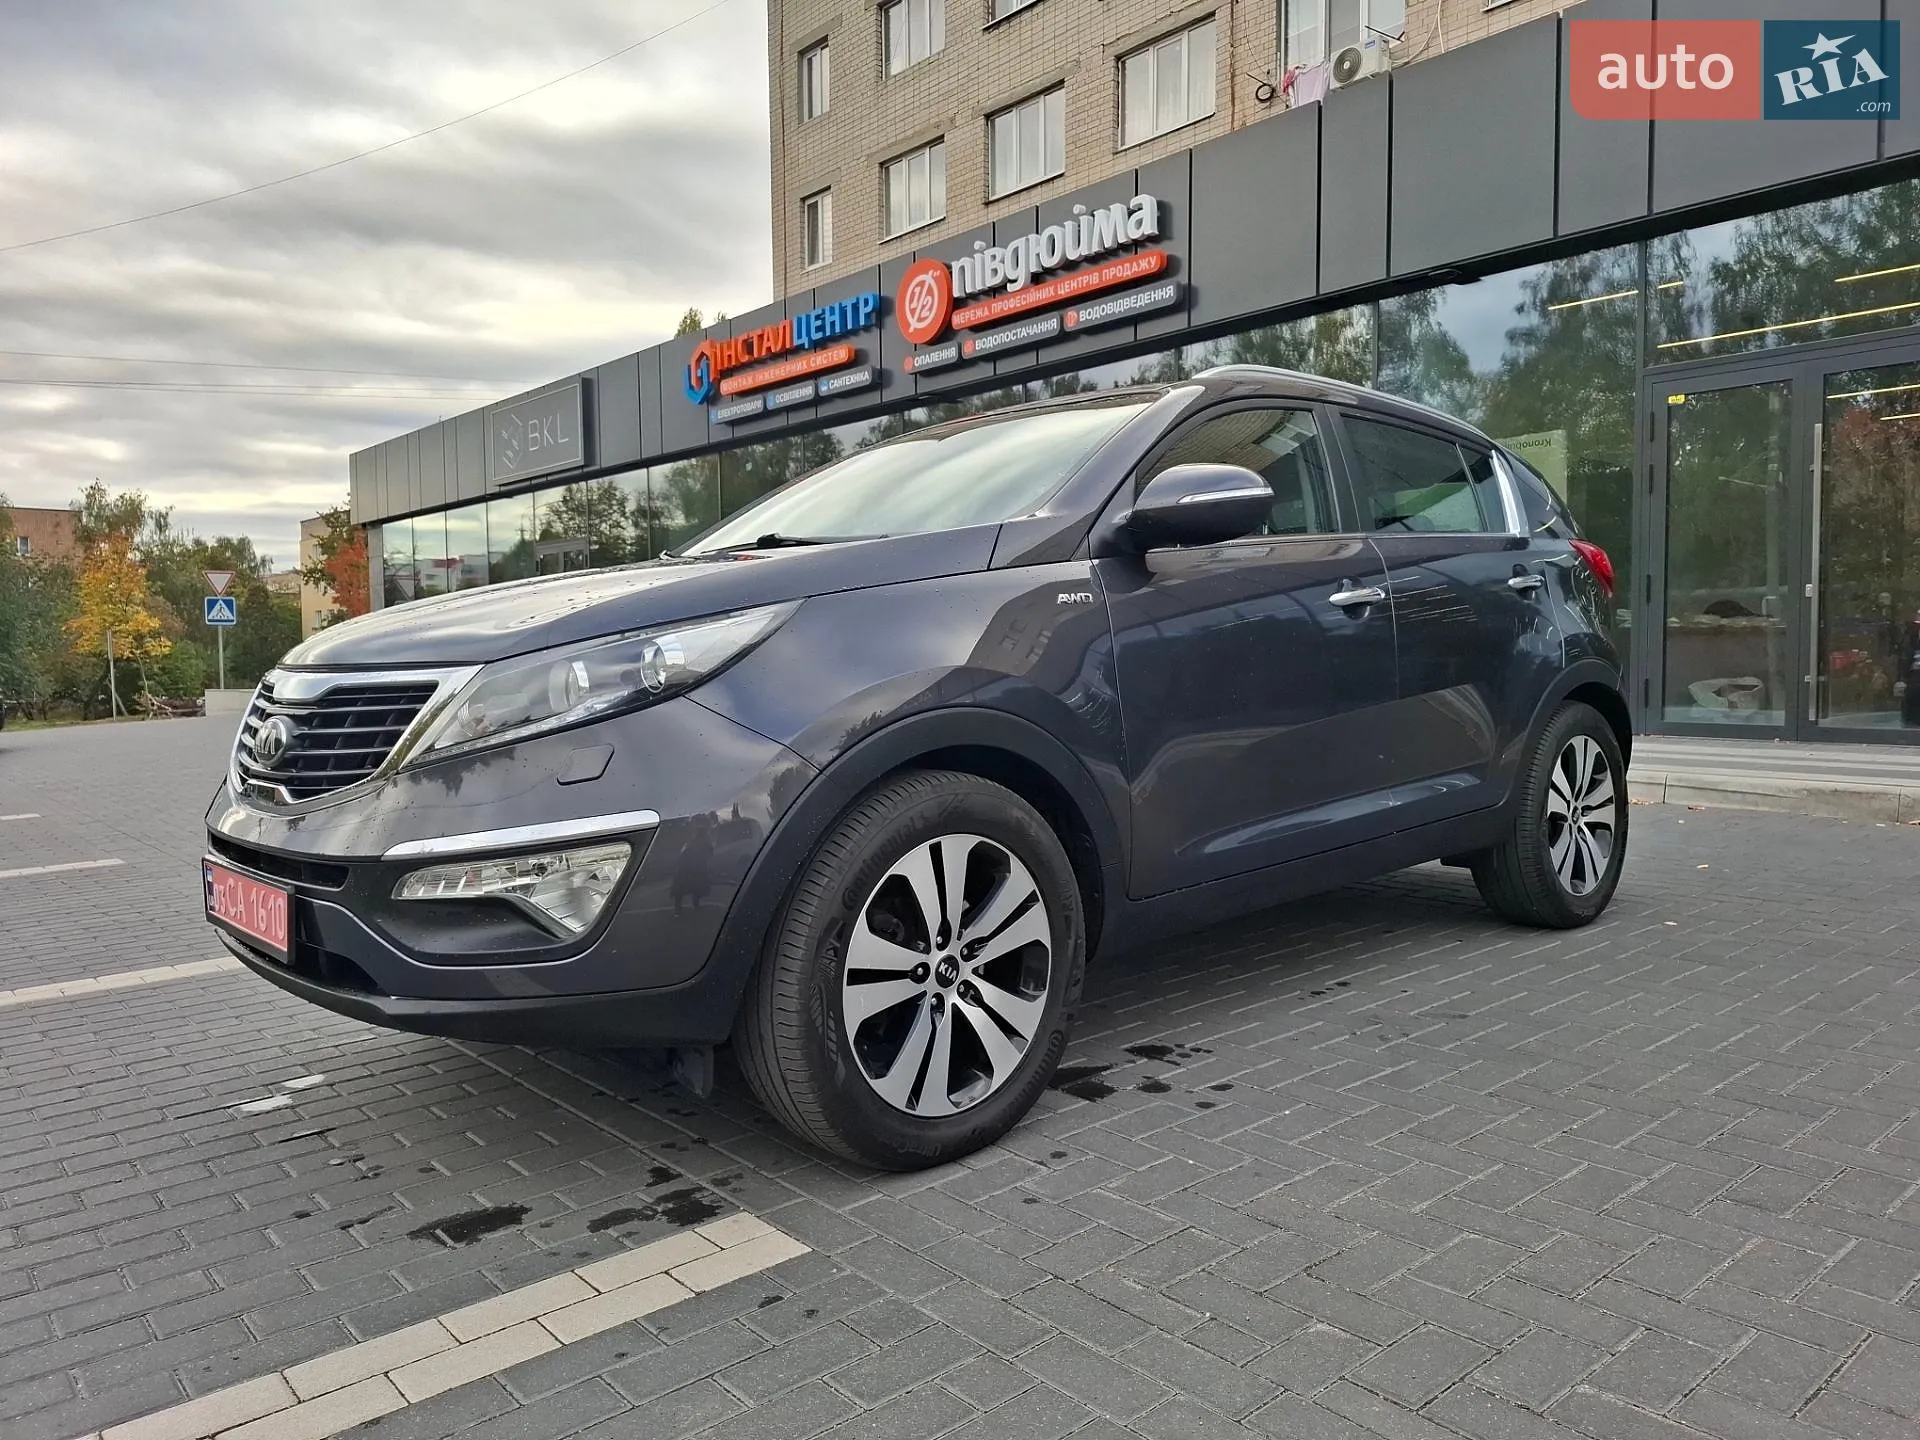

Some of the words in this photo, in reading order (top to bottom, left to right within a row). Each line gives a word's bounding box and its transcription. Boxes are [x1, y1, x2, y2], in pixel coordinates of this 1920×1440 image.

[951, 193, 1159, 298] півдюйма
[953, 307, 990, 326] МЕРЕЖА
[990, 285, 1055, 314] ПРОФЕСІЙНИХ
[1057, 272, 1100, 295] ЦЕНТРІВ
[1101, 255, 1157, 281] ПРОДАЖУ
[1079, 285, 1175, 322] ВОДОВІДВЕДЕННЯ
[975, 319, 1058, 351] ВОДОПОСТАЧАННЯ
[721, 374, 754, 392] МОНТАЖ
[755, 360, 808, 382] ІНЖЕНЕРНИХ
[810, 348, 847, 368] СИСТЕМ
[914, 346, 956, 367] ОПАЛЕННЯ
[828, 370, 870, 389] САНТЕХНІКА
[528, 412, 569, 451] BKL
[1057, 592, 1093, 604] AWD
[250, 887, 285, 940] 1610
[938, 961, 957, 982] KIA
